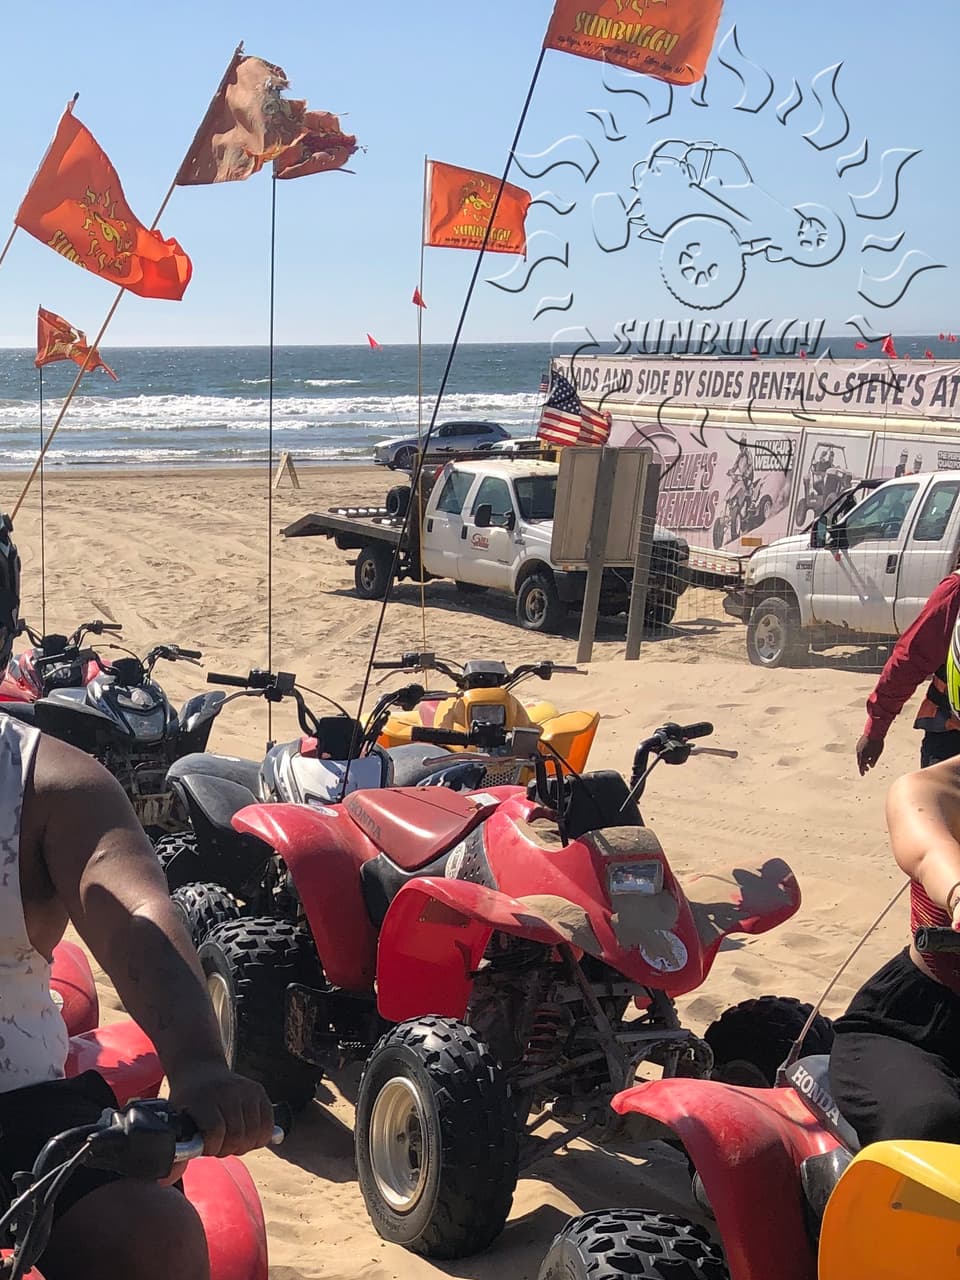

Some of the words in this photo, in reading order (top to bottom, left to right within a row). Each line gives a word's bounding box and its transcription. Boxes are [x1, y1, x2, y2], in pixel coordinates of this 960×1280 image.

[573, 11, 680, 56] SUNBUGGY
[601, 367, 633, 393] AND
[635, 368, 668, 396] SIDE
[673, 369, 696, 398] BY
[696, 369, 745, 400] SIDES
[747, 371, 829, 403] RENTALS
[841, 372, 927, 407] STEVE'S
[754, 455, 793, 470] WELCOME
[655, 490, 720, 530] RENTALS
[348, 799, 382, 841] HONDA
[790, 1065, 841, 1127] HONDA
